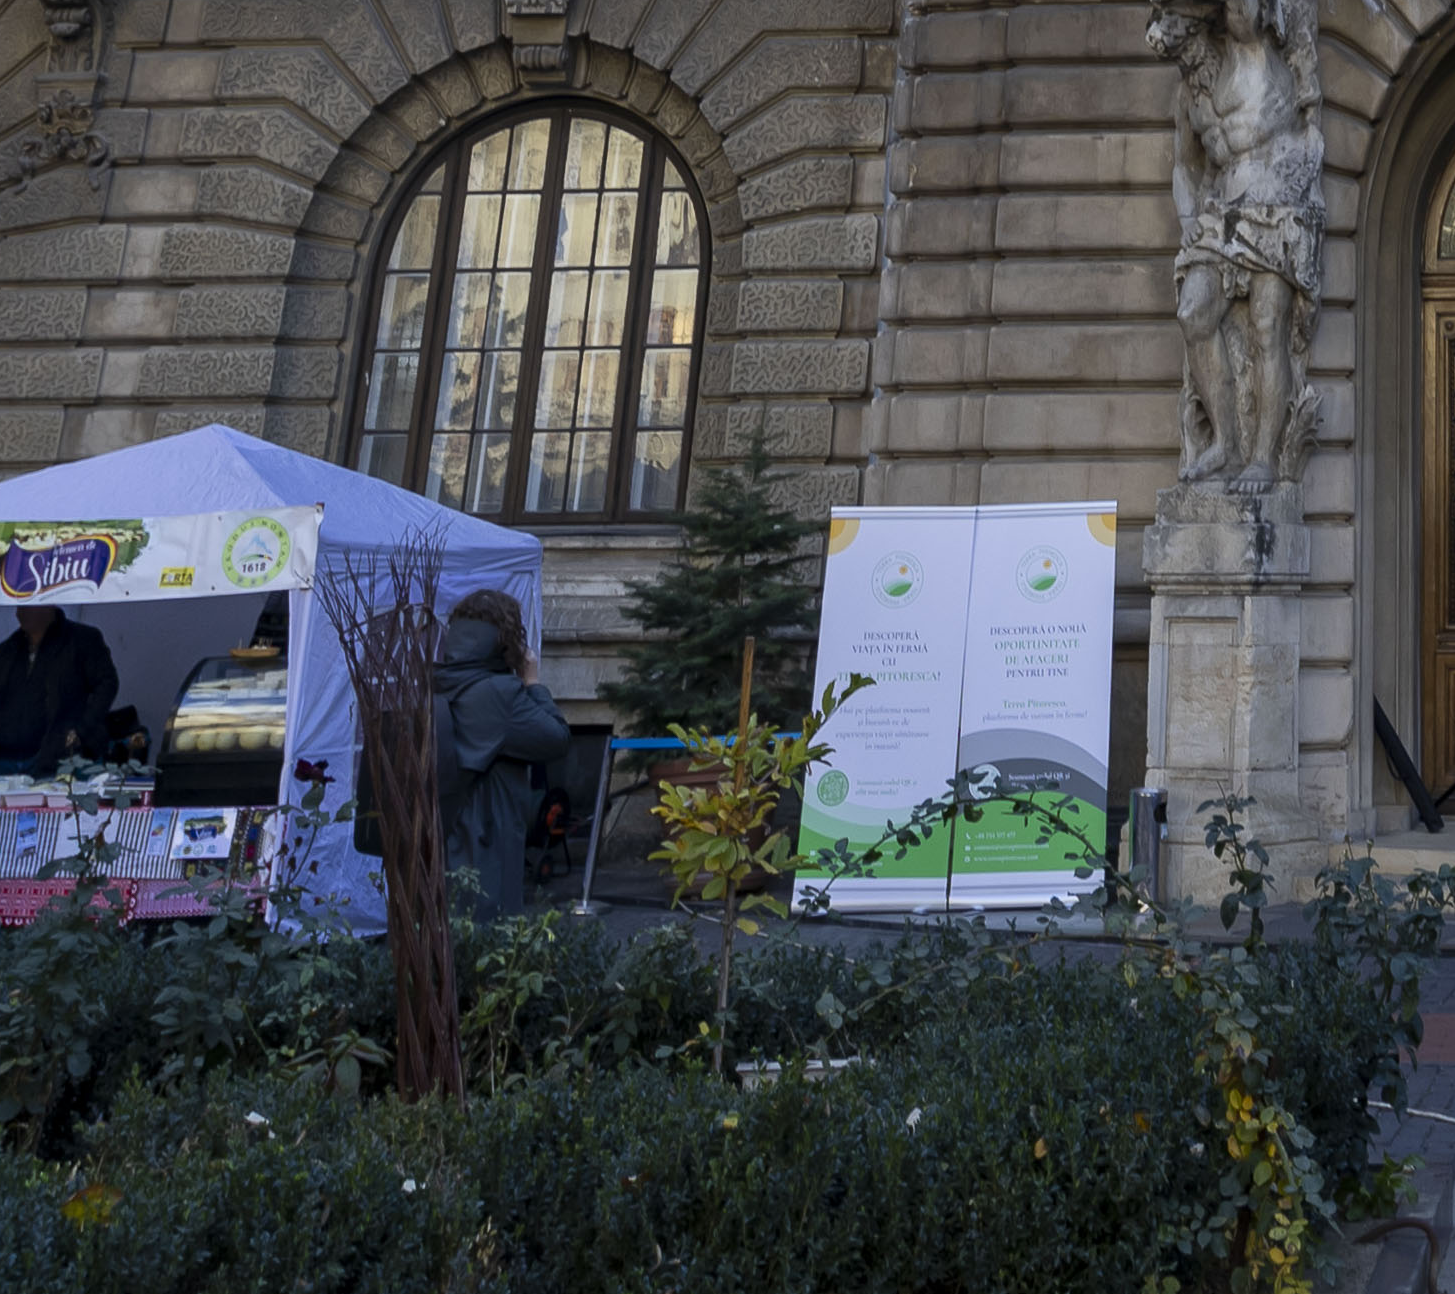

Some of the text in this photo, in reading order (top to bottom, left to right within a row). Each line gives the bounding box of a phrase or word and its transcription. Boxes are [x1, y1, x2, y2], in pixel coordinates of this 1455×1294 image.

[242, 562, 267, 573] 1618
[16, 553, 92, 595] Sibiu
[864, 630, 919, 641] DESCOPERĂ
[990, 626, 1045, 636] DESCOPERĂ
[1047, 626, 1056, 634] O
[994, 638, 1079, 651] OPORTUNITATE
[881, 657, 896, 667] CU
[1005, 654, 1069, 666] DE AFACERI
[1006, 668, 1069, 679] PENTRU TINE
